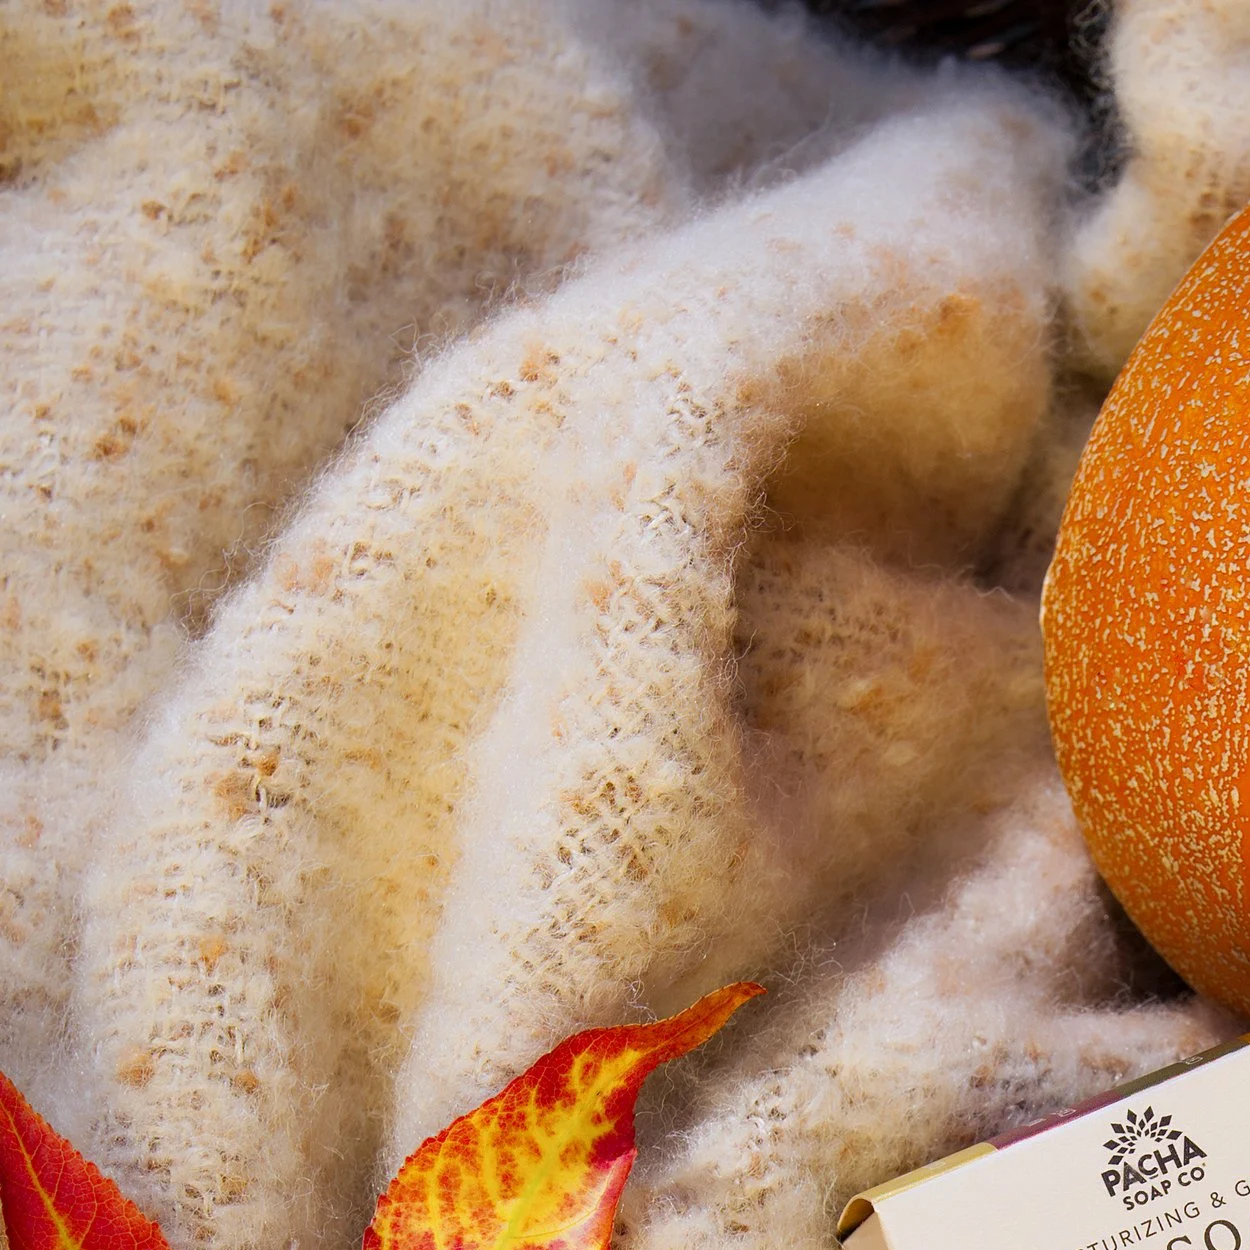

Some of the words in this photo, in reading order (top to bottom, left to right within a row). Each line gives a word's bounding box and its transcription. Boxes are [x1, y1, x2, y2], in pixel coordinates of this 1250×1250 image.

[1101, 1136, 1208, 1198] PACHA
[1122, 1179, 1173, 1210] SOAP
[1209, 1191, 1228, 1209] &
